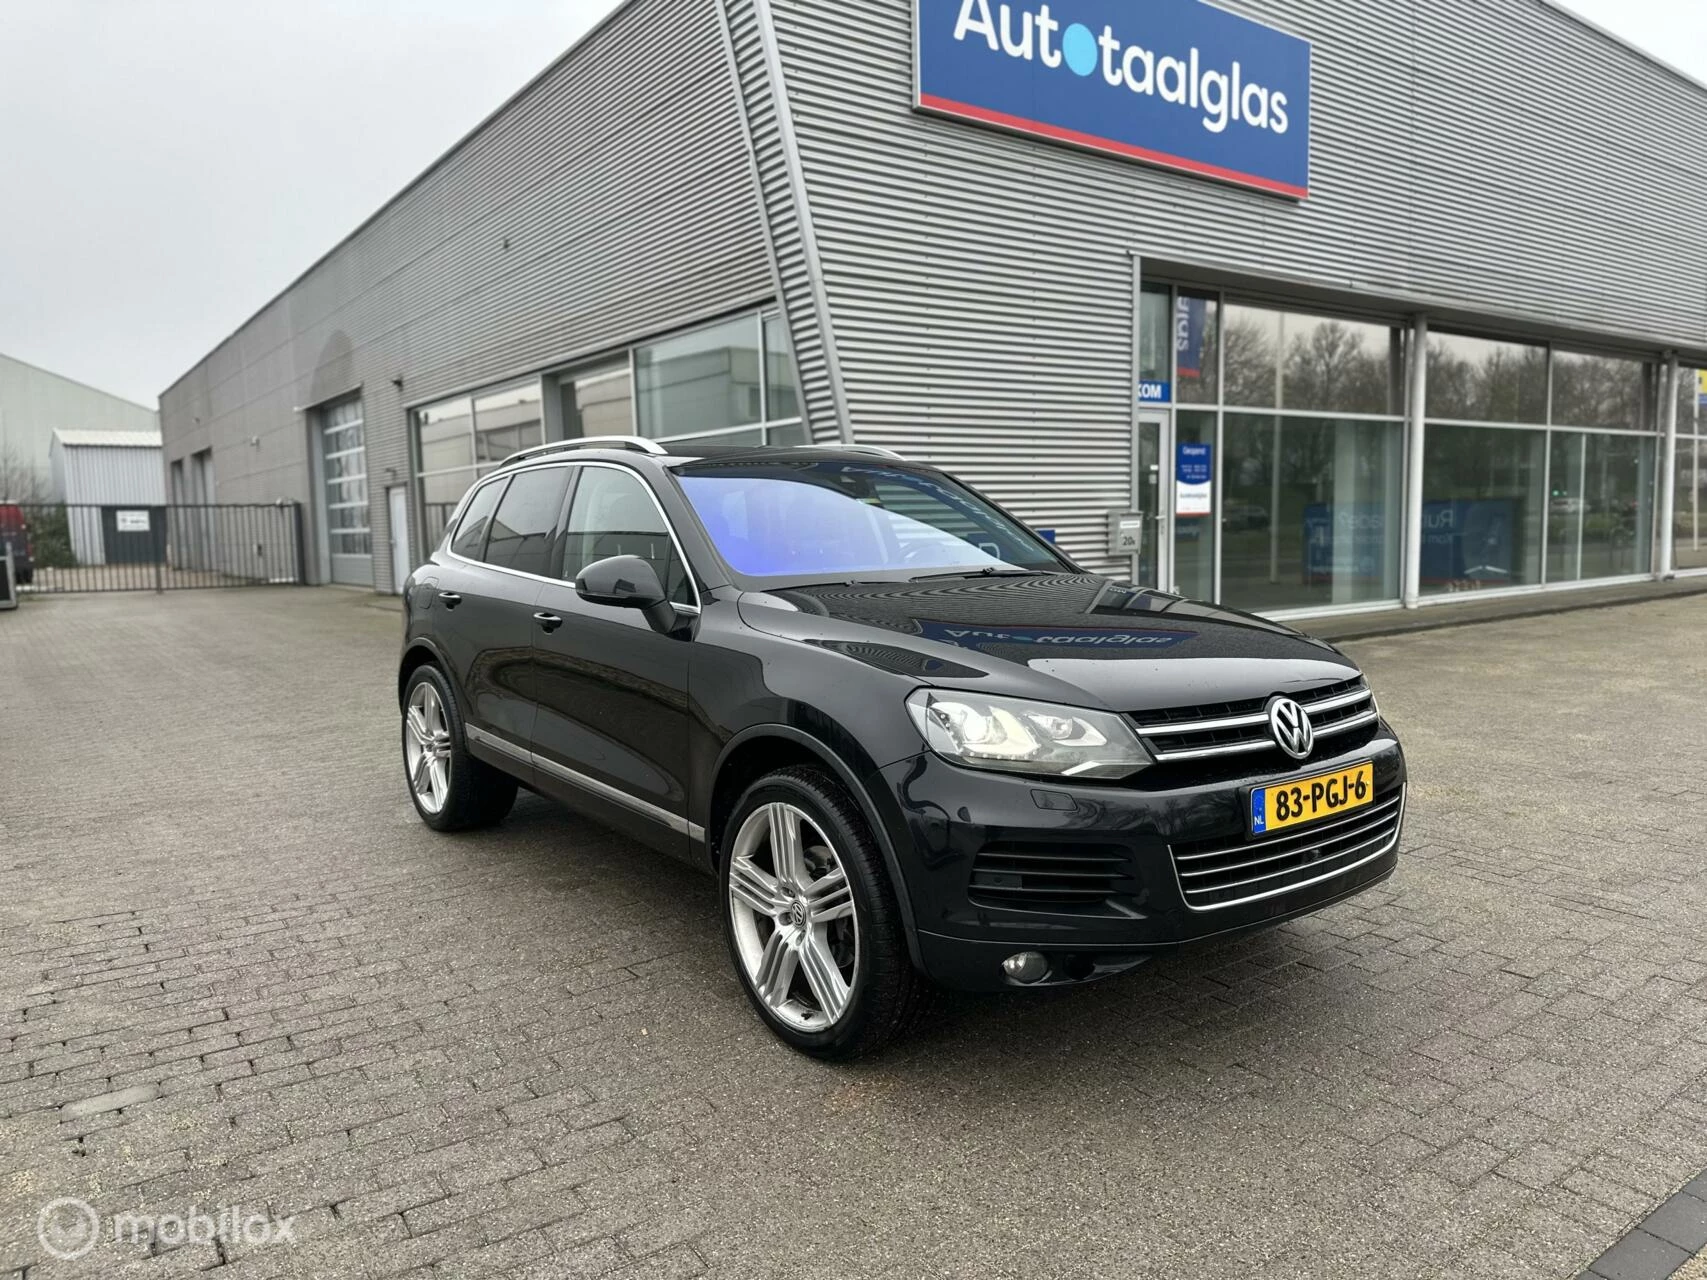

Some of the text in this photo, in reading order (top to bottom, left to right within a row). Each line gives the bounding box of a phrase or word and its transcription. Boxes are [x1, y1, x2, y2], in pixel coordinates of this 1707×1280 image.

[954, 0, 1289, 134] Autotaalglas
[1254, 816, 1264, 825] NL
[1276, 771, 1366, 822] 83-PGJ-6
